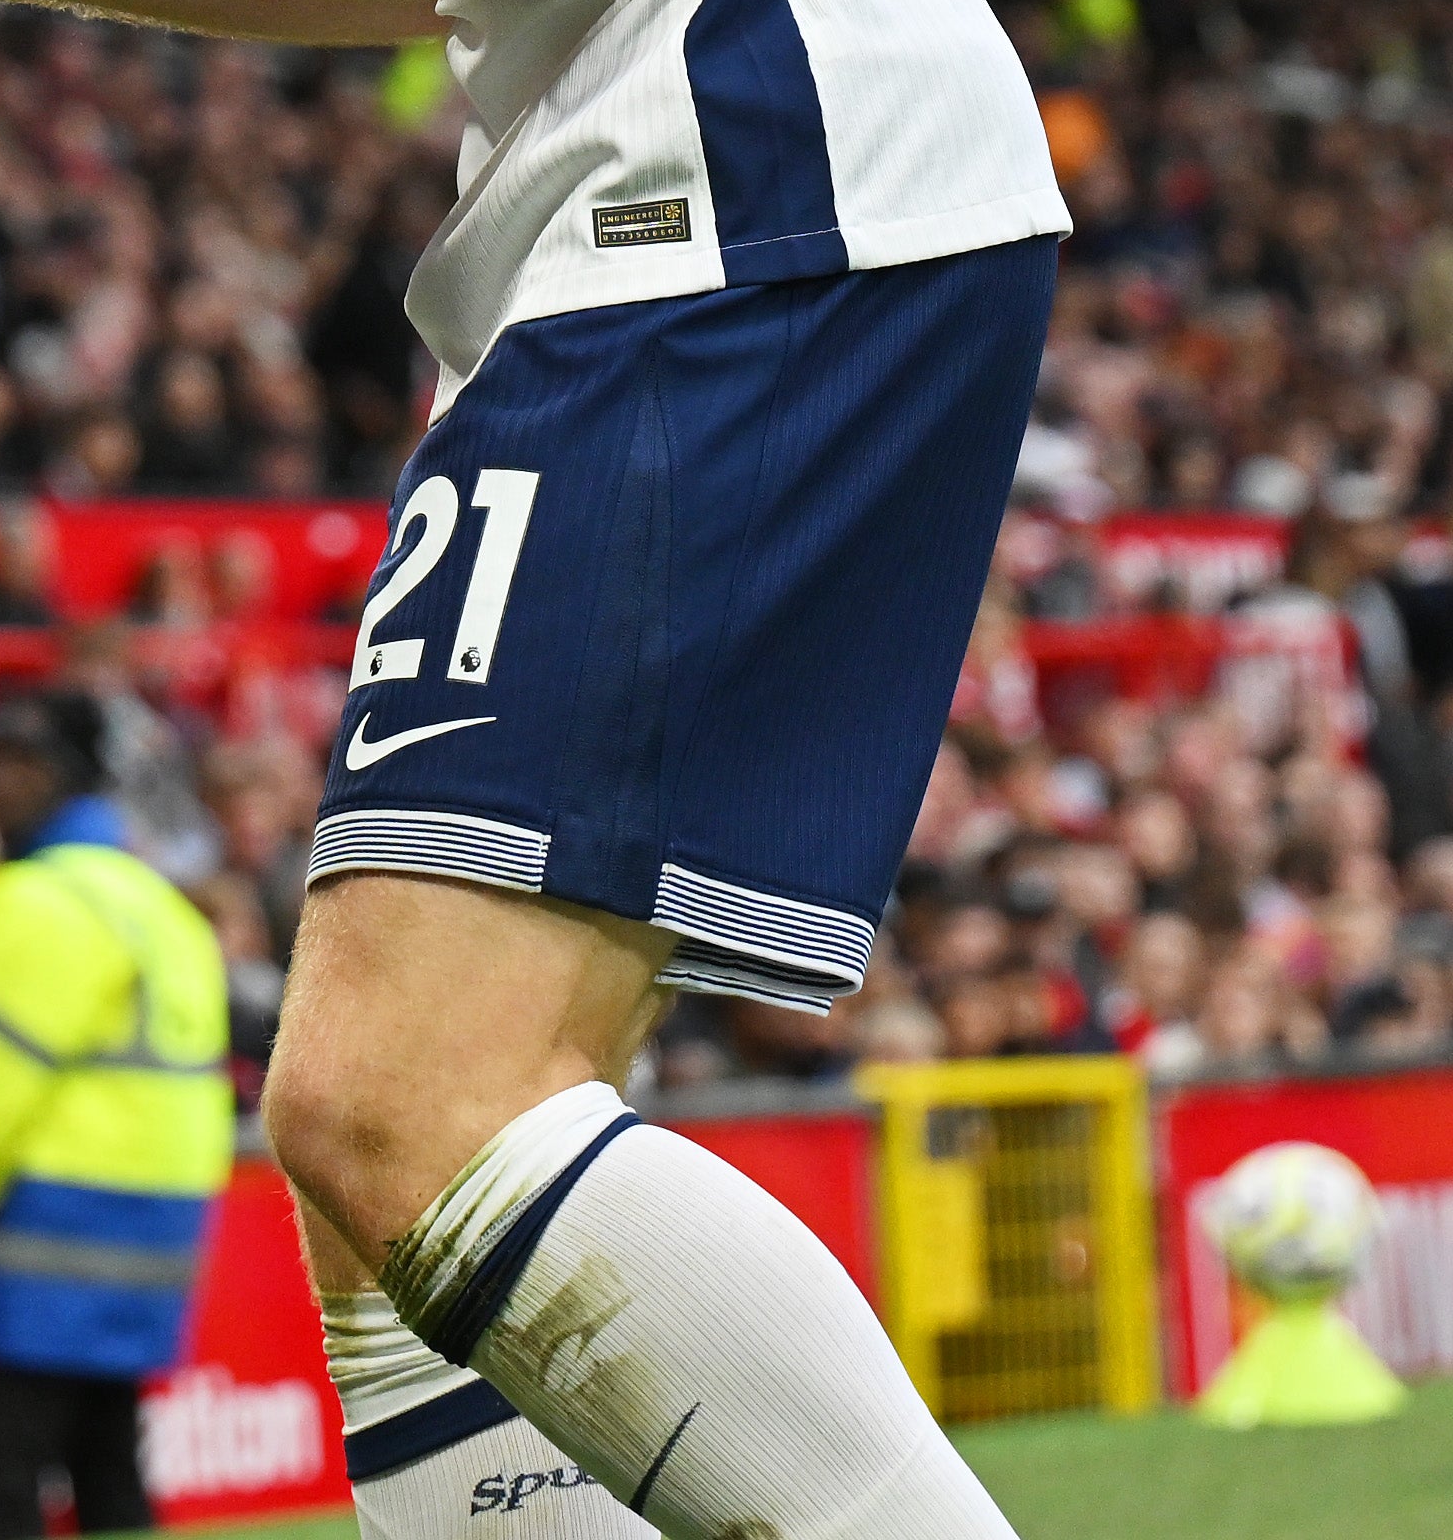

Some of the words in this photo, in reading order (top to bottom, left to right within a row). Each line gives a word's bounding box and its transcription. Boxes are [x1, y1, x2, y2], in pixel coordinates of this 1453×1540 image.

[601, 211, 660, 223] ENGINEERED
[347, 468, 541, 692] 21
[471, 1465, 601, 1517] spu
